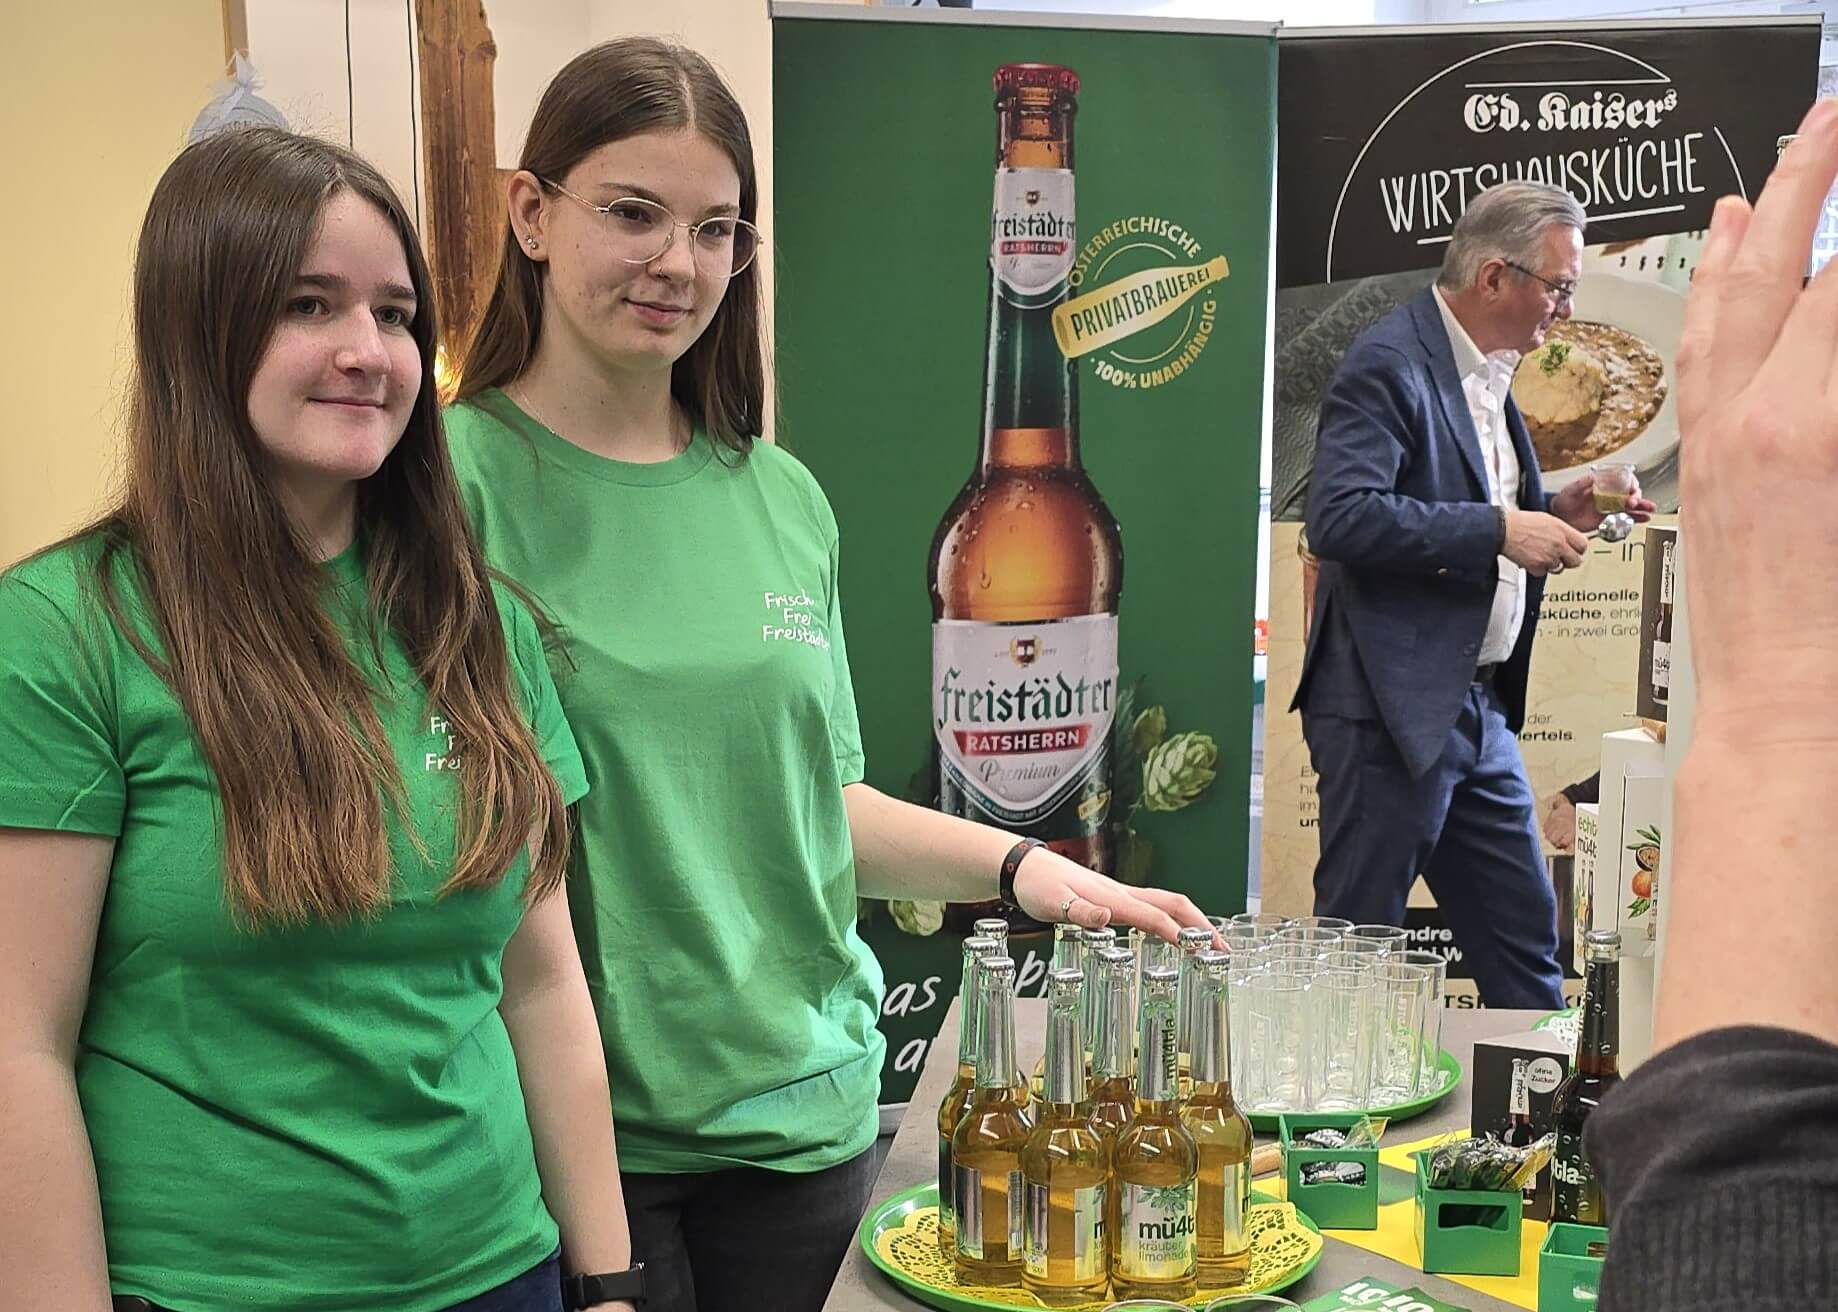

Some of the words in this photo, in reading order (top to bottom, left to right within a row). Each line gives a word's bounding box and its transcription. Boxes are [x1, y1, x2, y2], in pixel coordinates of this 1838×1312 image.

[1463, 93, 1531, 133] Ed.
[1537, 88, 1678, 132] Kaisers
[1070, 267, 1210, 341] PRIVATBRAUEREI
[1095, 360, 1137, 388] 100%
[1139, 300, 1217, 388] UNABHÄNGIG
[764, 588, 815, 609] Frisch
[783, 607, 812, 626] Frei
[938, 667, 1112, 730] freistädter
[966, 729, 1080, 752] RATSHERRN
[980, 759, 1060, 783] Premium
[1139, 1215, 1195, 1240] mü4t
[1138, 1240, 1183, 1252] kräuter
